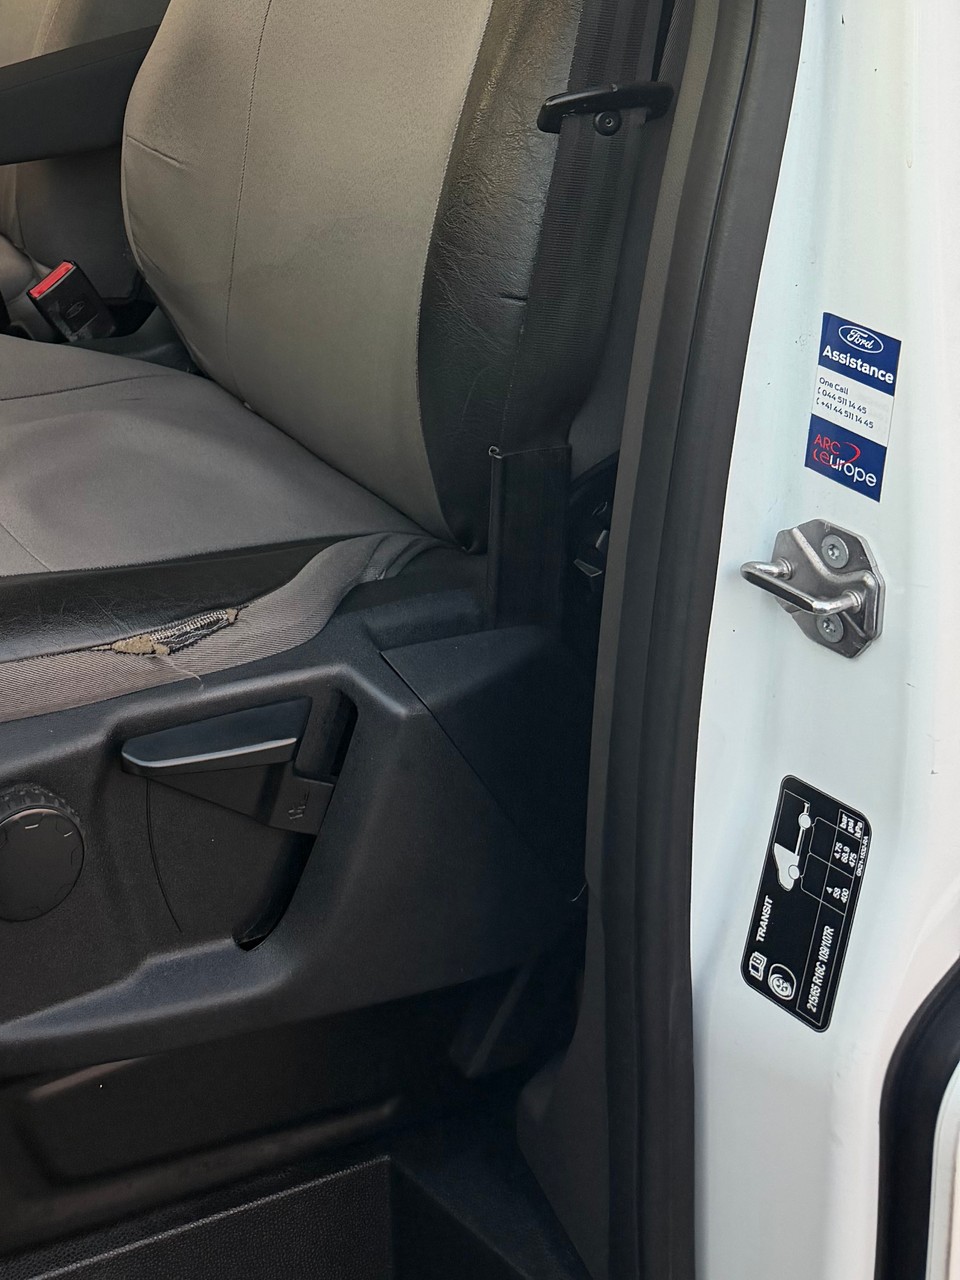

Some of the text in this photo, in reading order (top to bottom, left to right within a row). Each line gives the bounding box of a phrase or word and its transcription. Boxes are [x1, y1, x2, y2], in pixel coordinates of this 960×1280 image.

[846, 328, 874, 350] Ford
[822, 345, 894, 385] Assistance
[819, 376, 849, 395] One Call
[822, 389, 867, 415] 044 511 14 45
[821, 401, 874, 429] +41 44 511 14 45
[813, 434, 840, 455] ARC
[819, 449, 877, 487] europe
[839, 813, 848, 829] bar
[847, 818, 855, 834] psi
[854, 821, 863, 838] kPa
[833, 841, 843, 859] 4.75
[848, 852, 857, 868] 475
[826, 886, 833, 894] 4
[840, 887, 849, 903] 400
[755, 894, 773, 942] TRANSIT
[806, 925, 835, 1013] 215/65 R16C 109/107R
